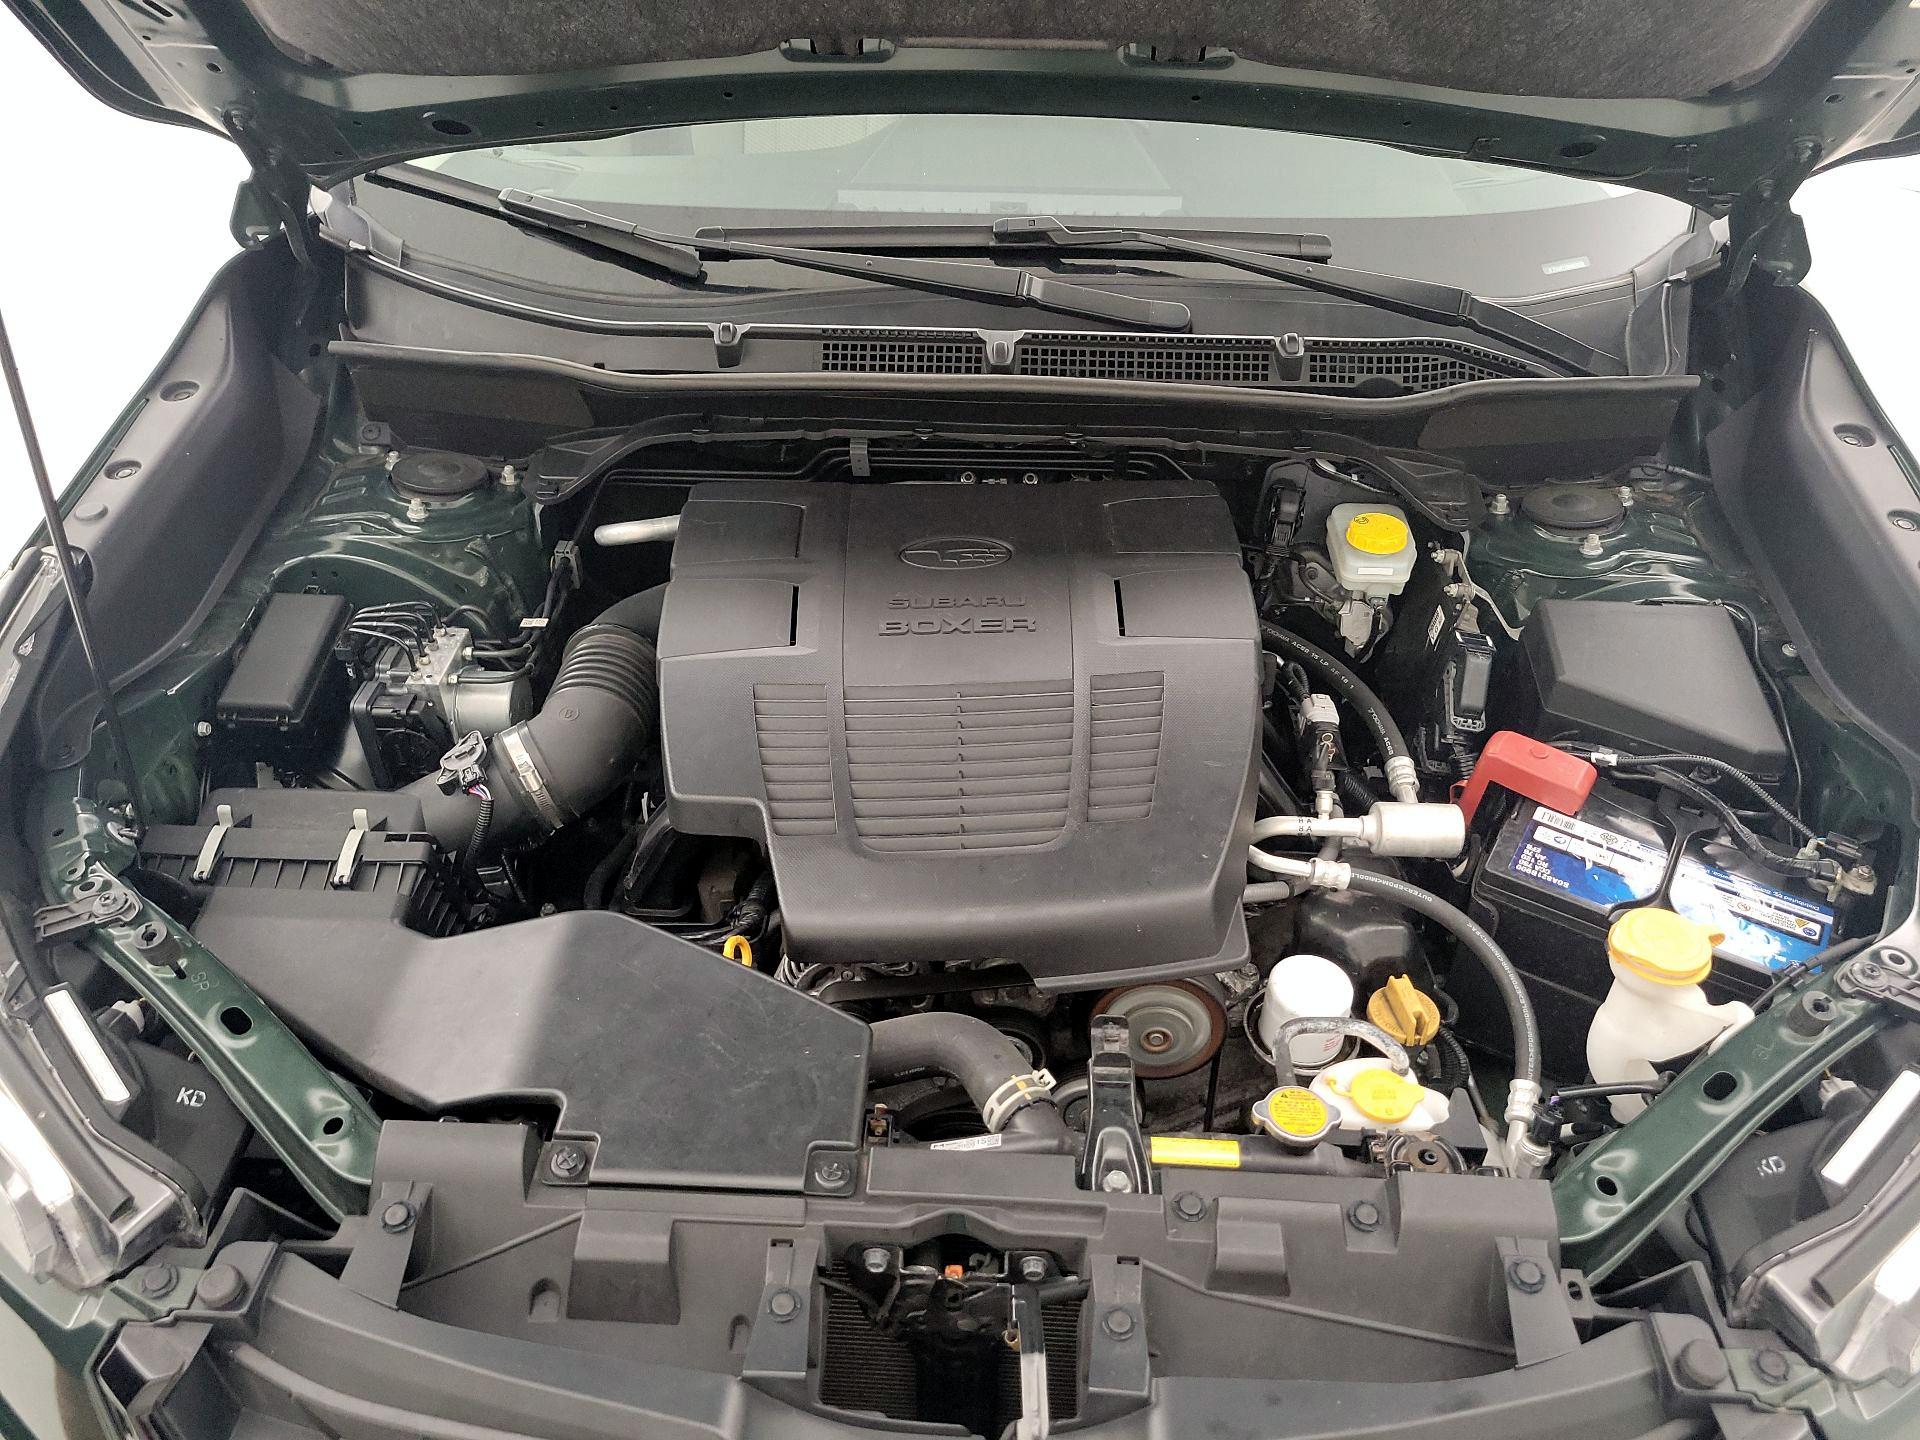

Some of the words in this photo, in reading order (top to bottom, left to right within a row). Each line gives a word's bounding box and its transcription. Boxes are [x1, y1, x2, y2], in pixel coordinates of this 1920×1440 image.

[888, 596, 1027, 610] SUBARU
[878, 615, 1037, 636] BOXER
[1534, 865, 1550, 874] CCA
[176, 1086, 207, 1107] KD
